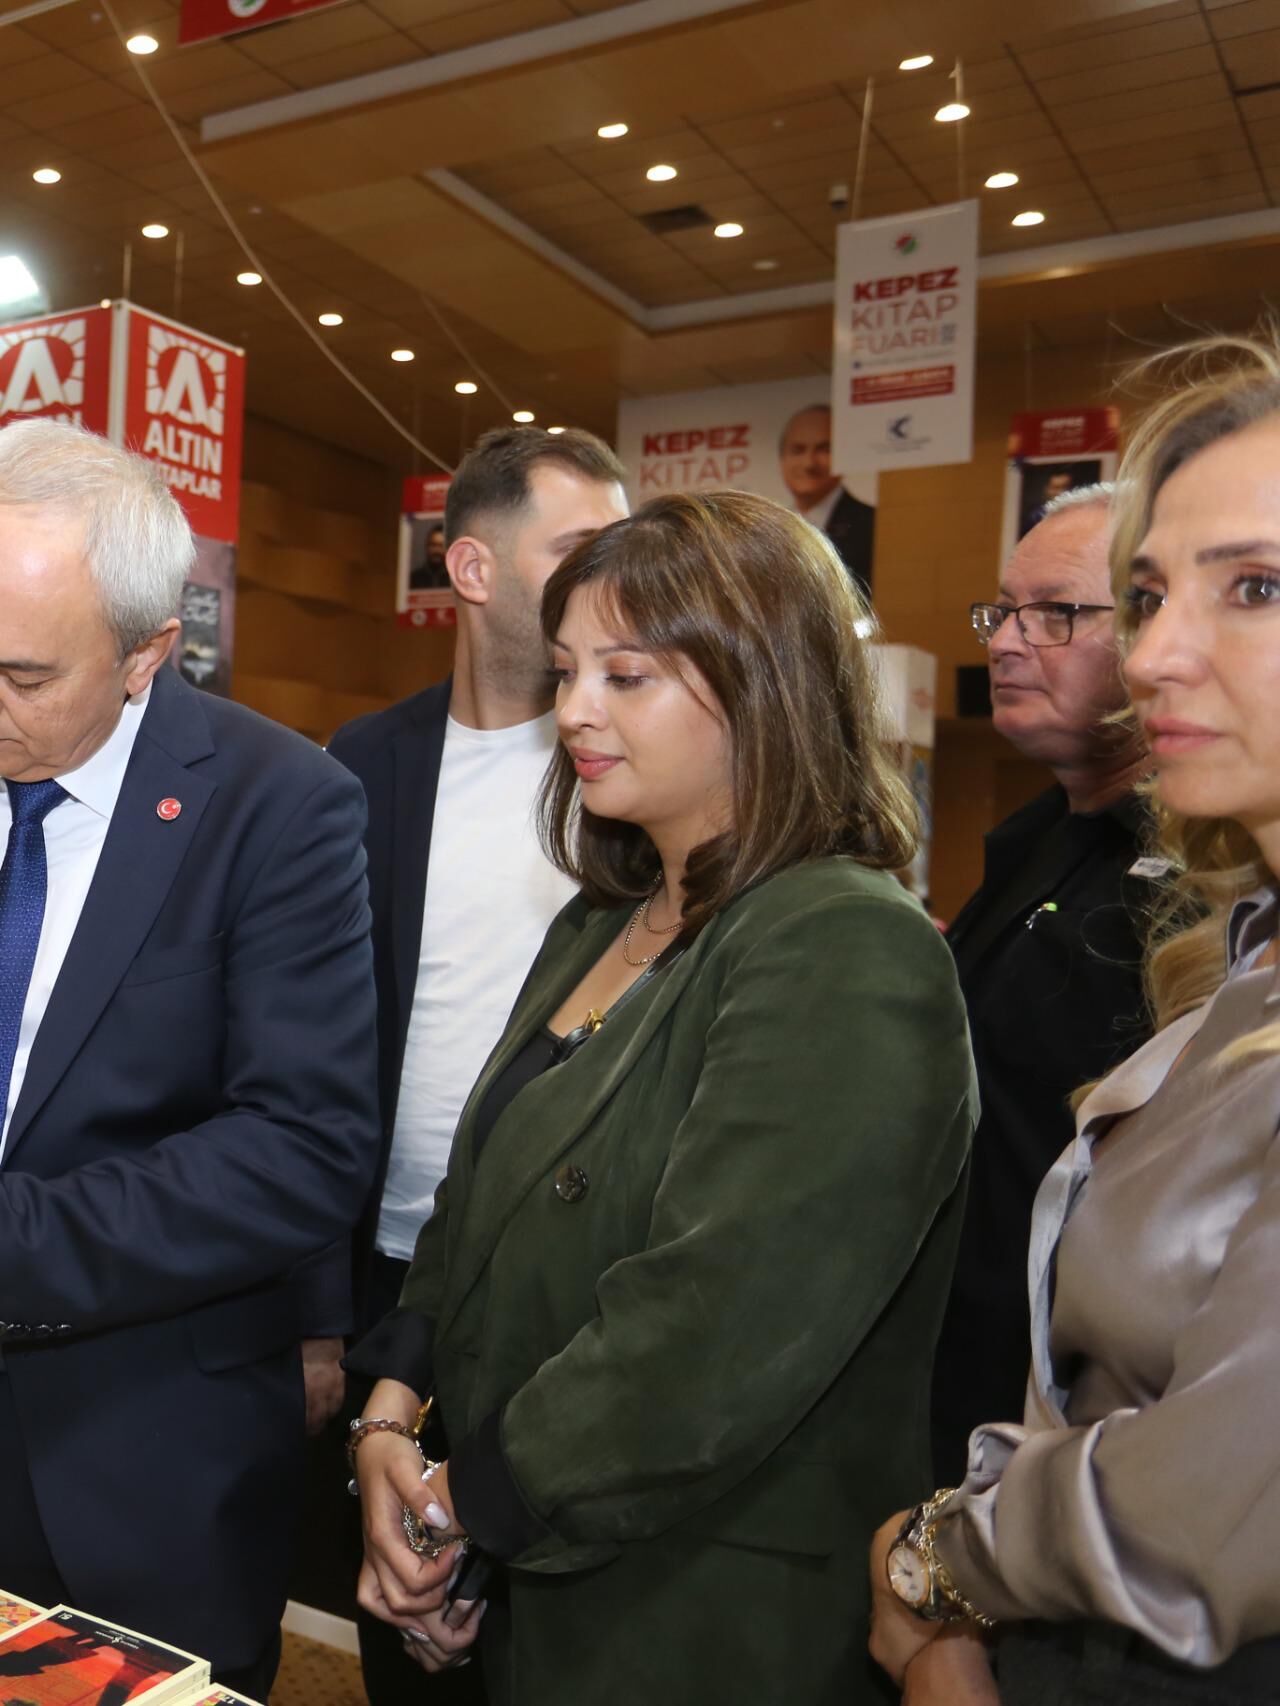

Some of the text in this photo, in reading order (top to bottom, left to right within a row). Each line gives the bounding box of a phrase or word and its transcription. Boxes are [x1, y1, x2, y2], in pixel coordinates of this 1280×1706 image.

[853, 267, 959, 304] KEPEZ
[851, 295, 959, 332] KİTAP
[851, 326, 938, 355] FUARI
[144, 423, 223, 474] ALTIN
[642, 424, 750, 458] KEPEZ
[156, 456, 222, 500] İTAPLAR
[639, 453, 750, 488] KİTAP
